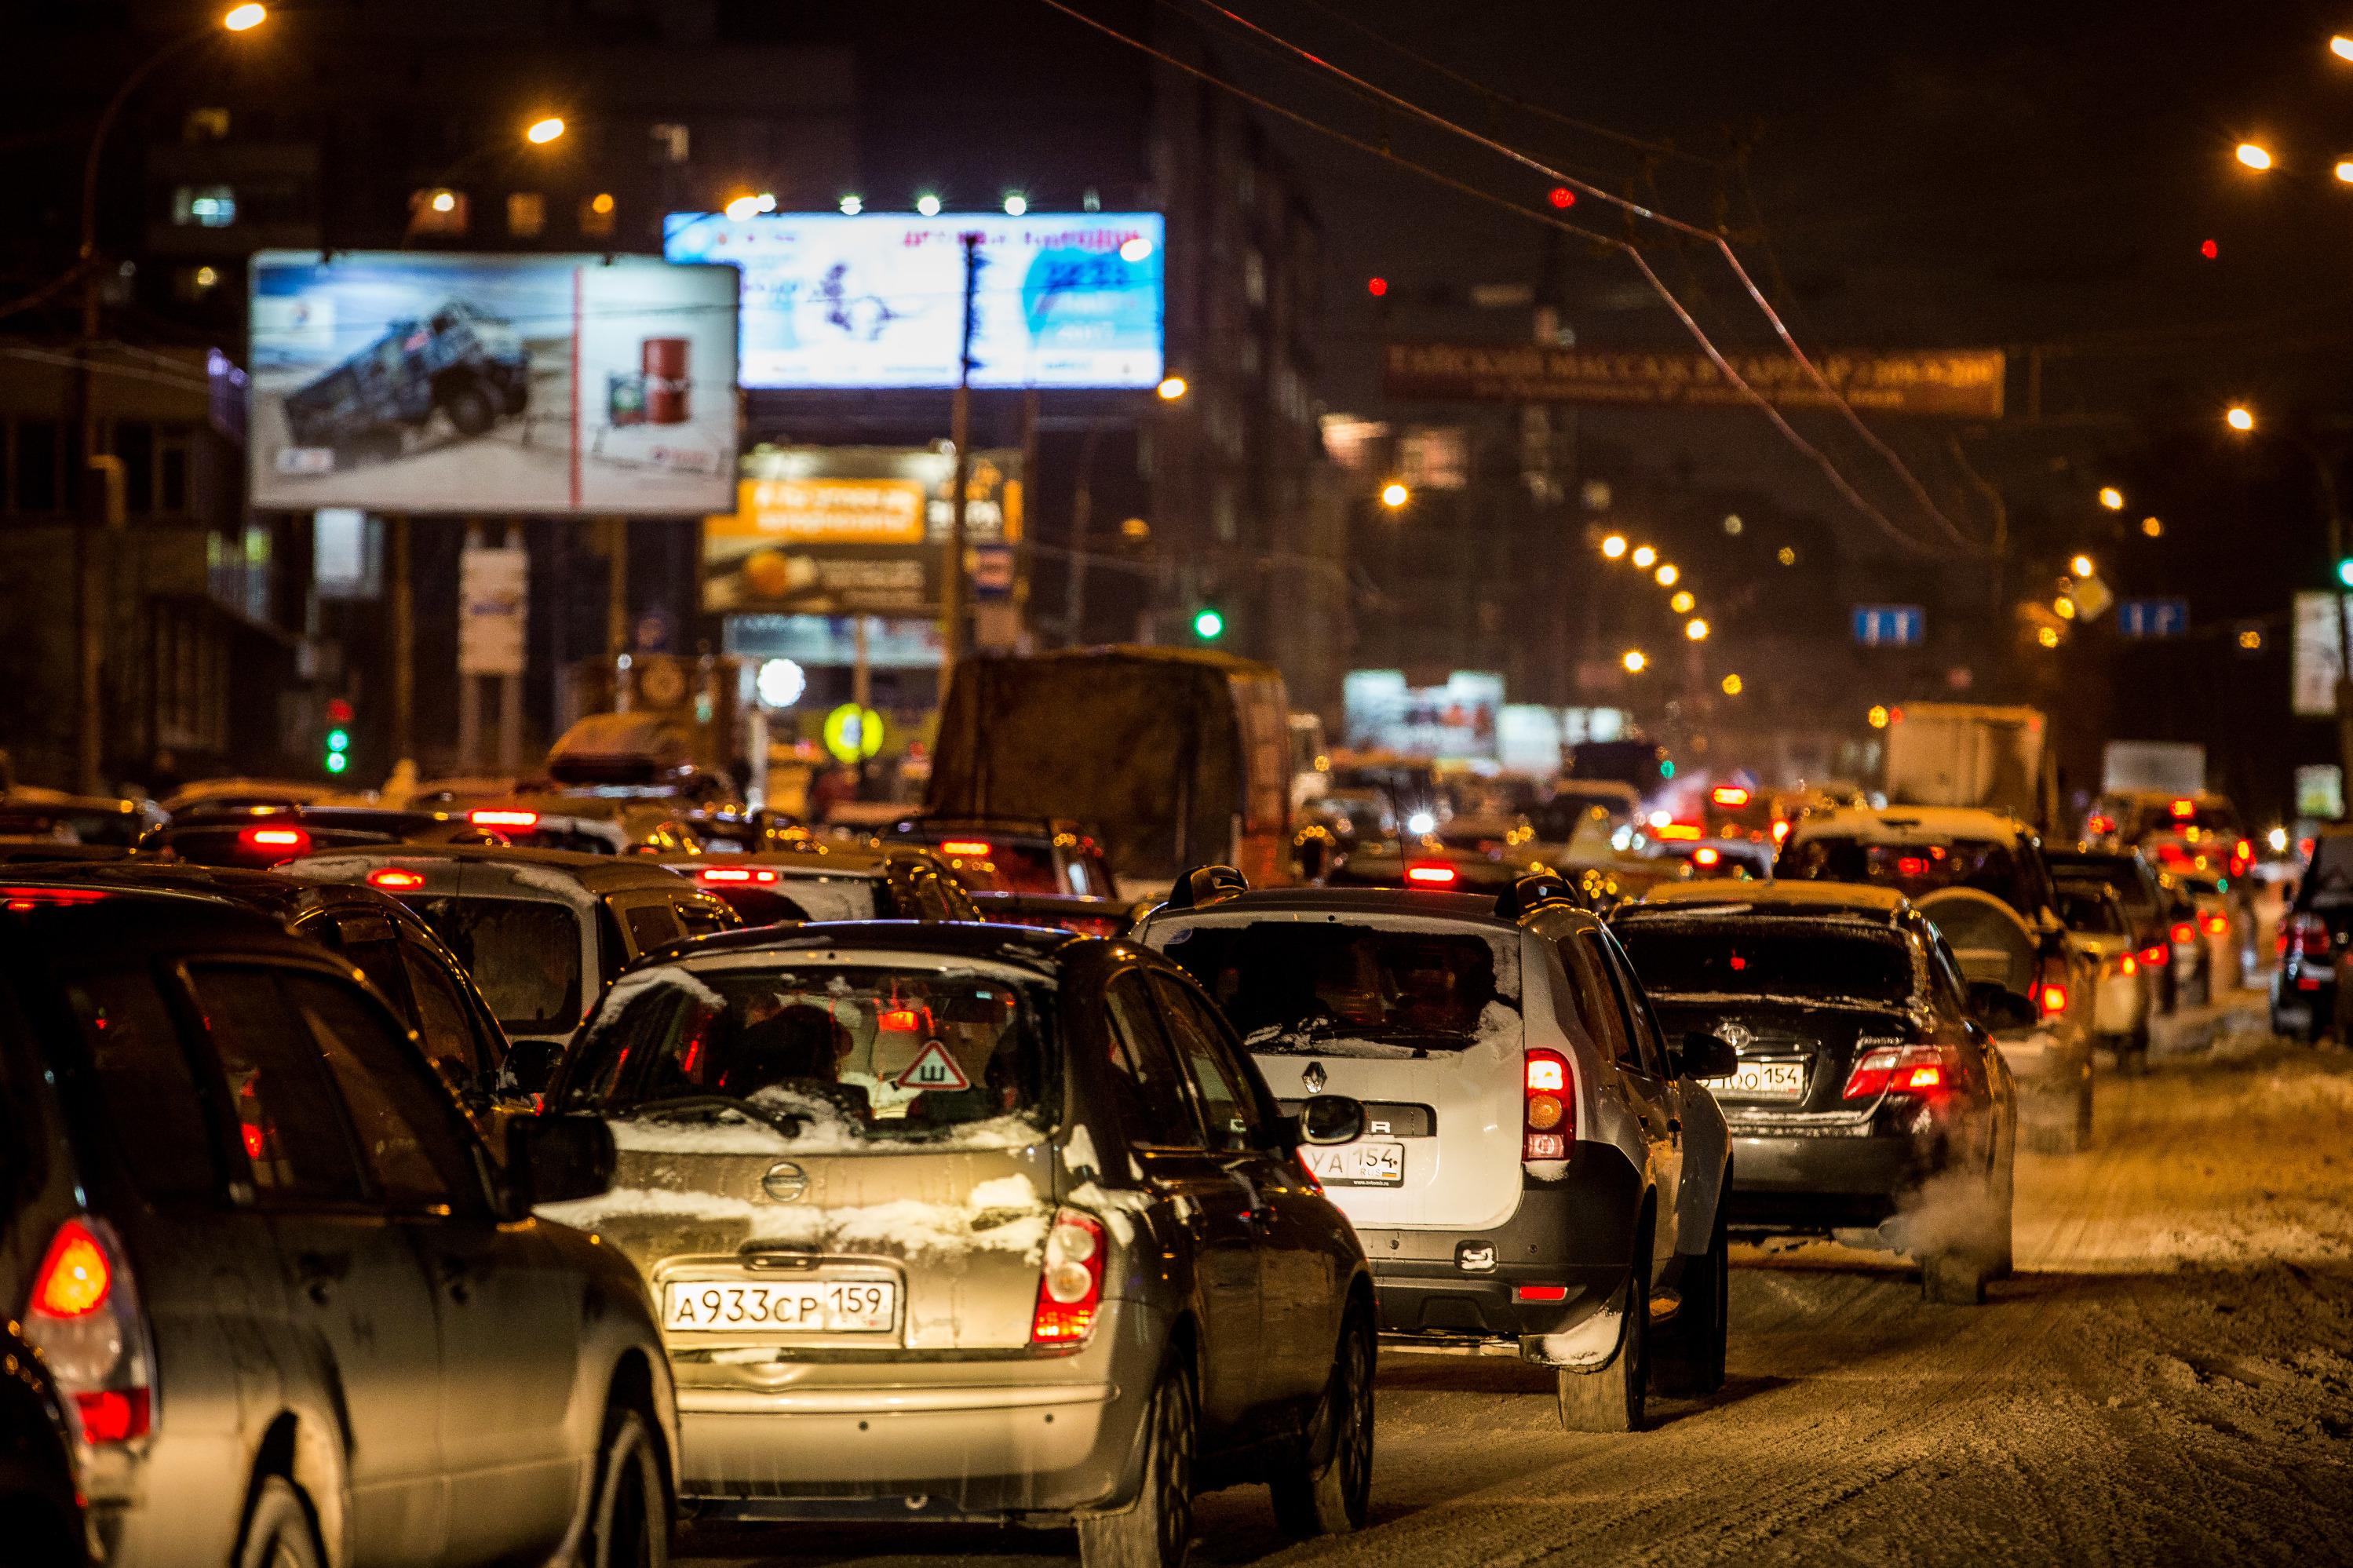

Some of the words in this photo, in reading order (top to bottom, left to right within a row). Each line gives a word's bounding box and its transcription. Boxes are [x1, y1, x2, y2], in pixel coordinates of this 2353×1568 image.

[920, 1064, 946, 1081] Ш
[1764, 1067, 1797, 1085] 154
[1352, 1147, 1394, 1169] 154
[676, 1289, 819, 1324] А933СР
[830, 1287, 882, 1315] 159
